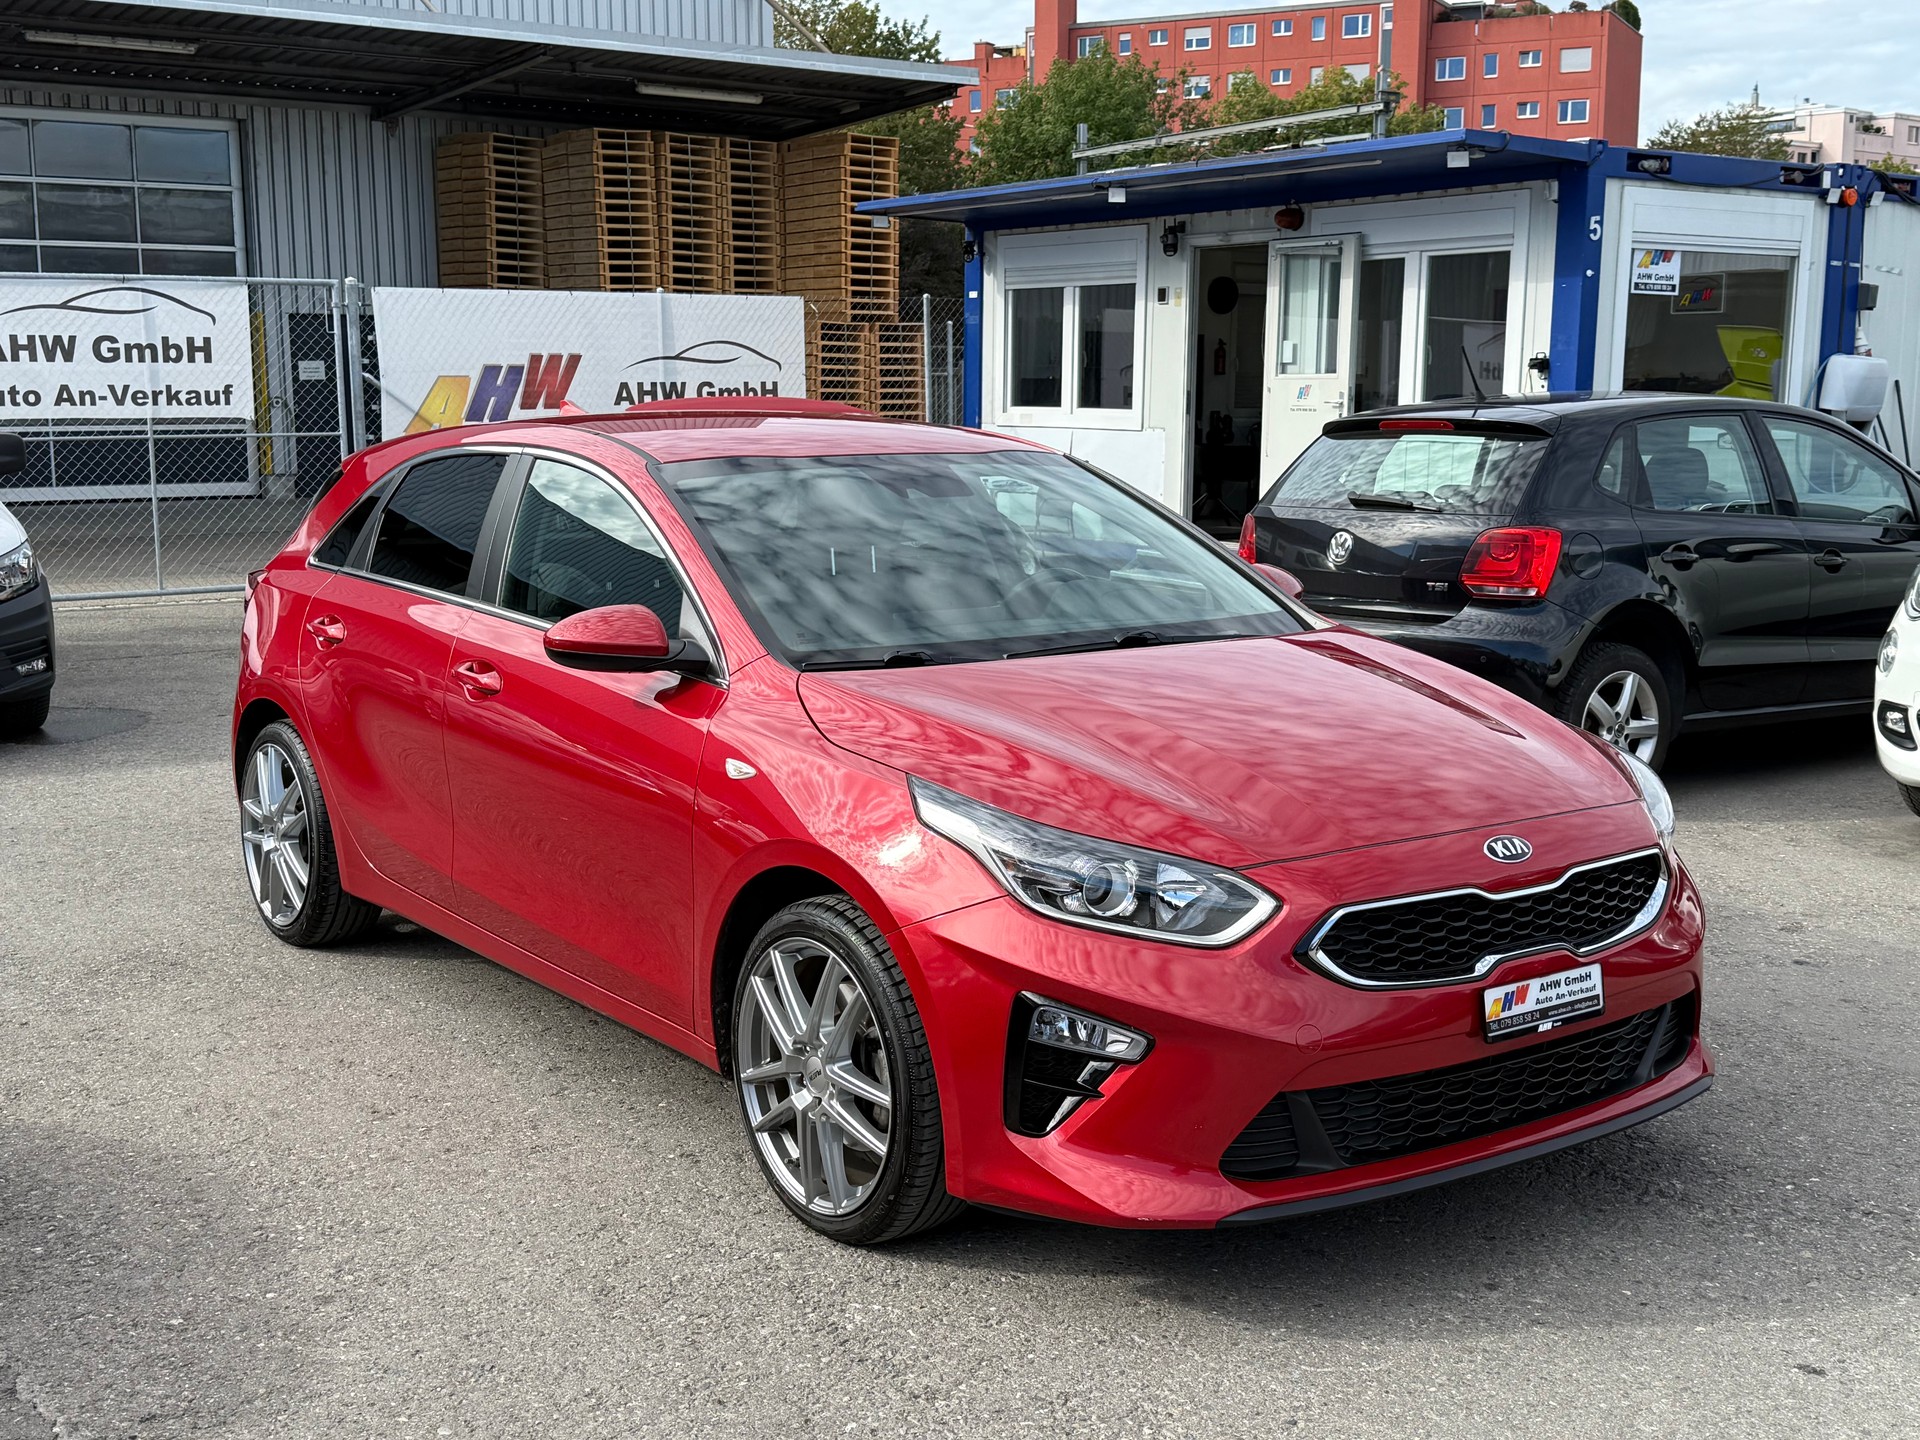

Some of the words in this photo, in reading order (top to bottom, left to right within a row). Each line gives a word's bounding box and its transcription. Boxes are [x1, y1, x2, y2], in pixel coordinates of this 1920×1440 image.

[1589, 215, 1601, 241] 5
[1637, 272, 1653, 281] AHW
[1654, 273, 1674, 282] GmbH
[92, 335, 213, 364] GmbH
[0, 384, 42, 407] to
[54, 384, 234, 407] An-Verkauf
[403, 352, 583, 437] AHW
[614, 381, 687, 406] AHW
[1426, 581, 1449, 592] TSI
[1489, 838, 1530, 858] KIA
[1539, 978, 1561, 993] AHW
[1564, 971, 1592, 987] GmbH
[1487, 983, 1531, 1020] AHW
[1535, 997, 1553, 1006] Auto
[1555, 983, 1597, 1001] An-Verkauf
[1501, 1017, 1512, 1028] 079
[1532, 1010, 1540, 1020] 24
